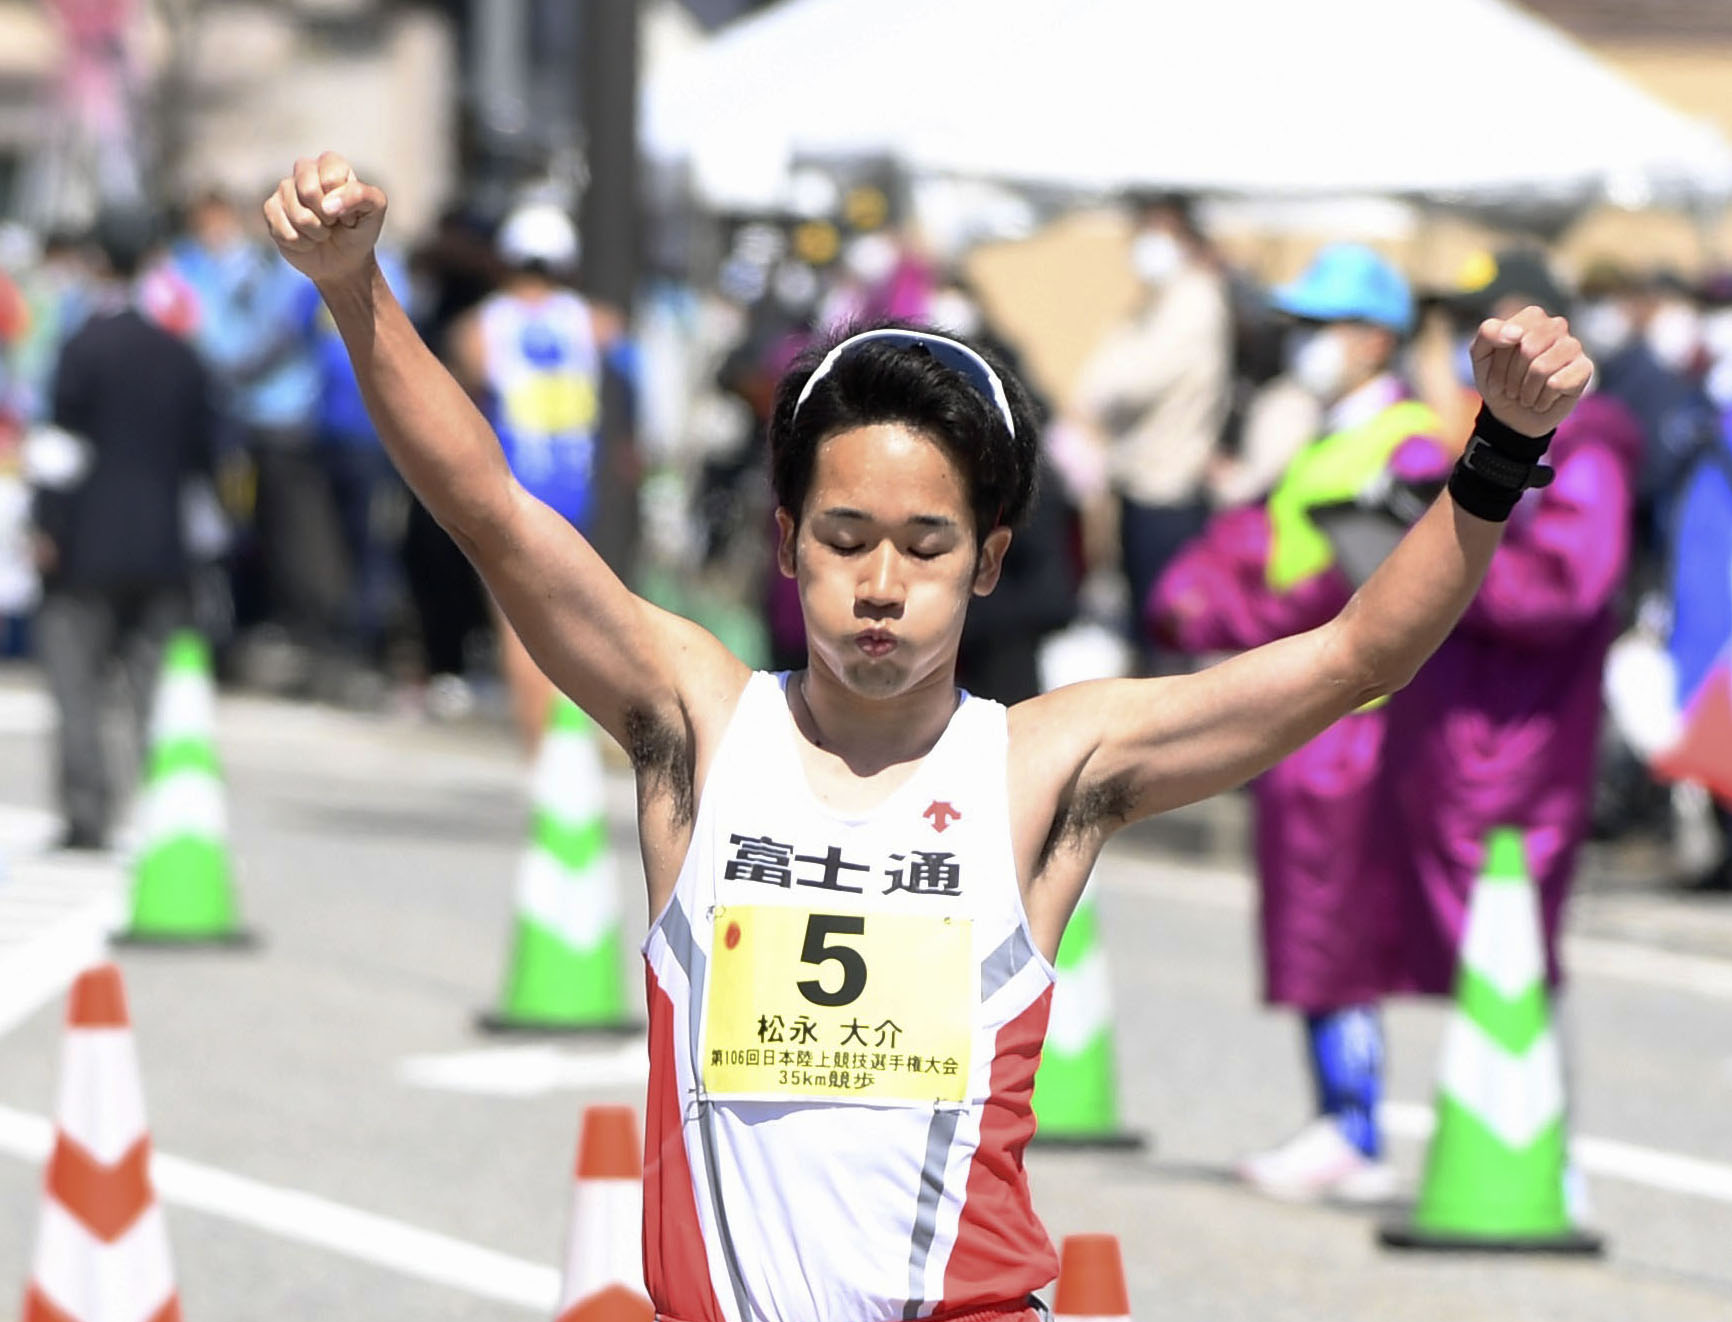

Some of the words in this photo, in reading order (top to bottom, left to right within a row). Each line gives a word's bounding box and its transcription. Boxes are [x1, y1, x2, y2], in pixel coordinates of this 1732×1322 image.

[724, 833, 962, 896] 富士通
[796, 913, 868, 1007] 5
[757, 1015, 818, 1045] 松永
[840, 1018, 903, 1049] 大介
